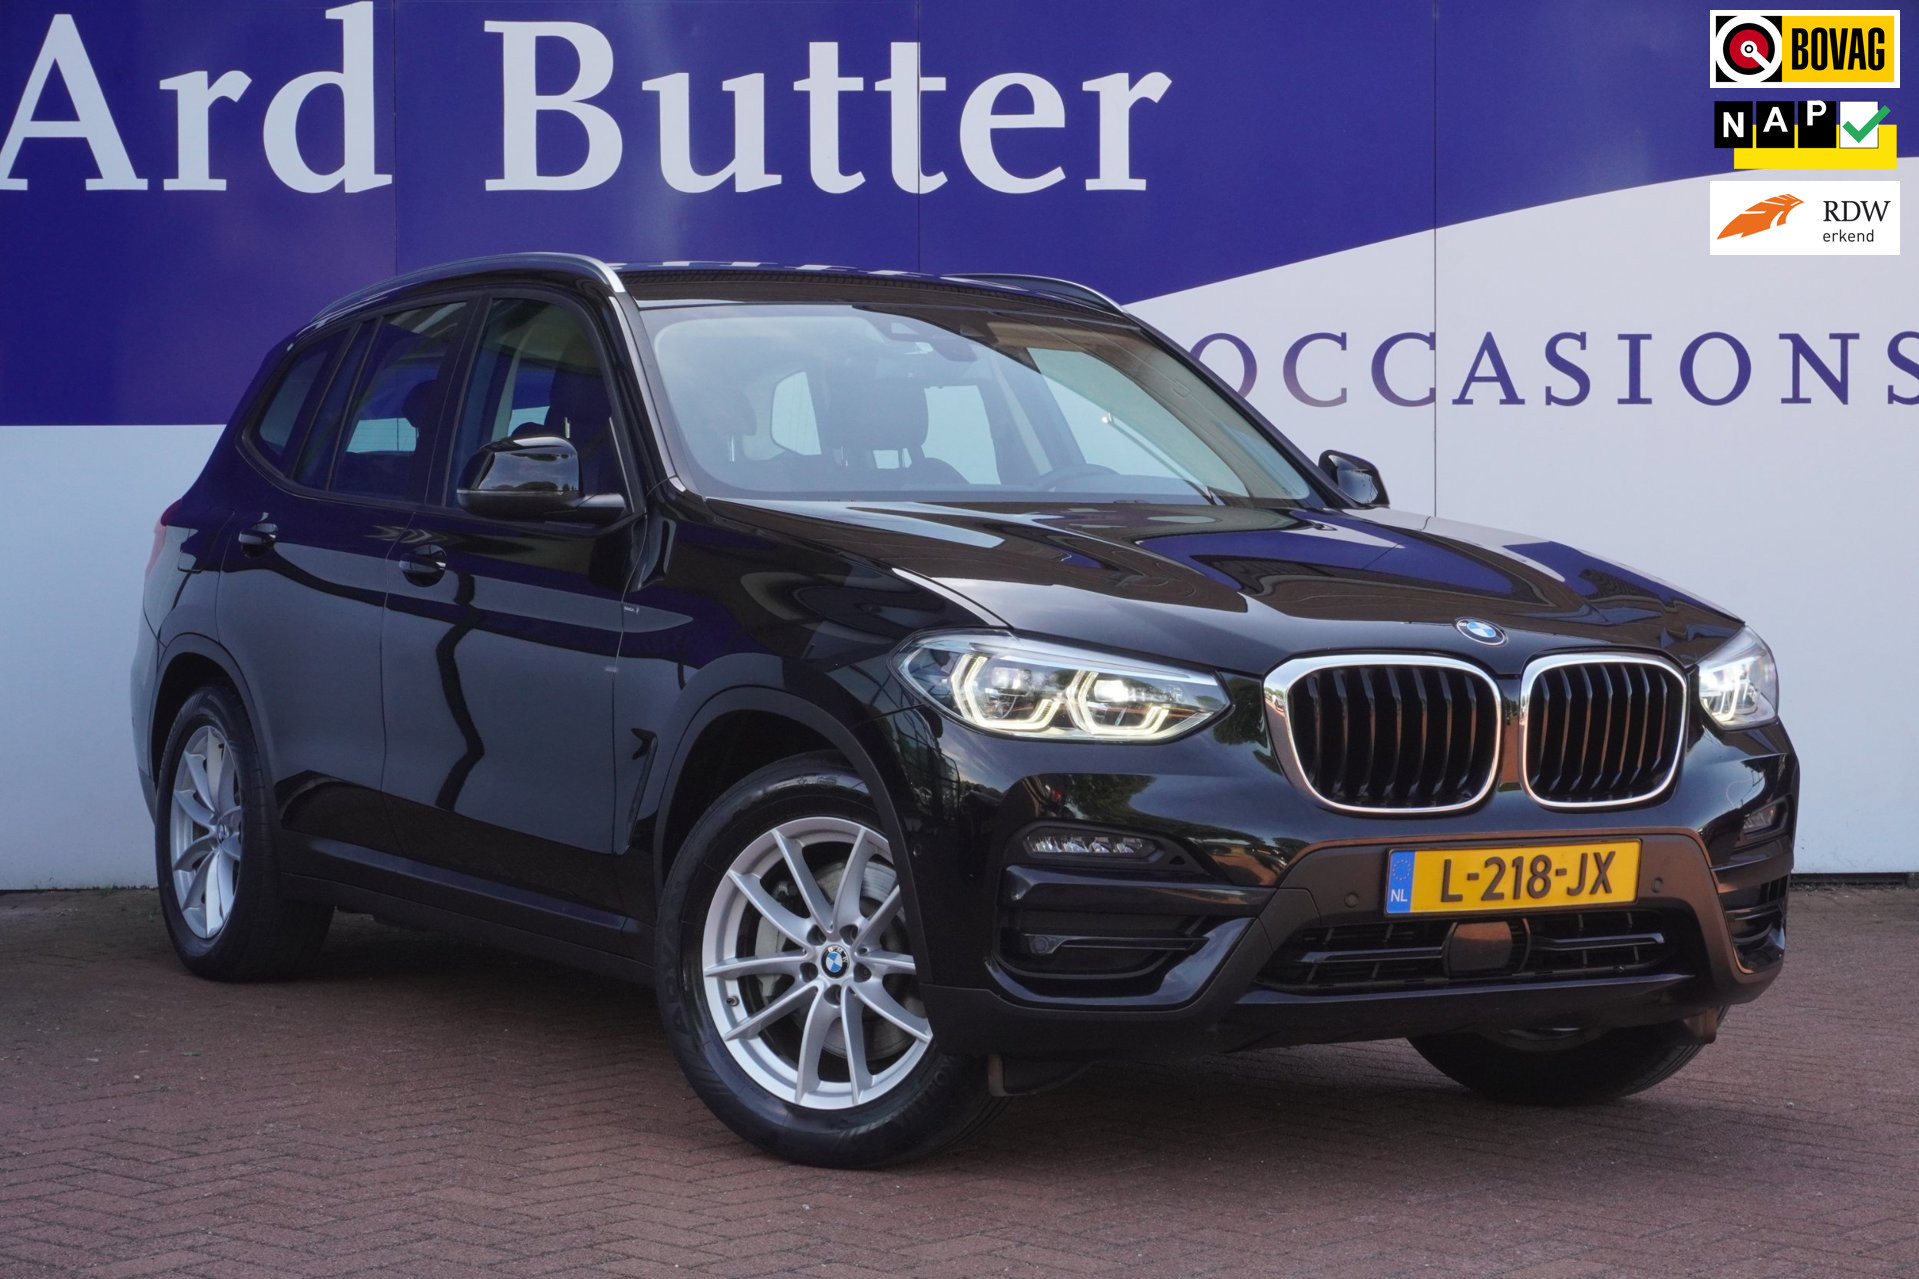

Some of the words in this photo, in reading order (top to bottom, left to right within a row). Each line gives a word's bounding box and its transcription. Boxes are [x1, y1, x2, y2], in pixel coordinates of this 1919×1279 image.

[0, 1, 393, 194] Ard
[484, 20, 1173, 194] Butter
[1187, 331, 1919, 407] OCCASIONS
[1390, 888, 1408, 903] NL
[1440, 851, 1616, 903] L-218-JX
